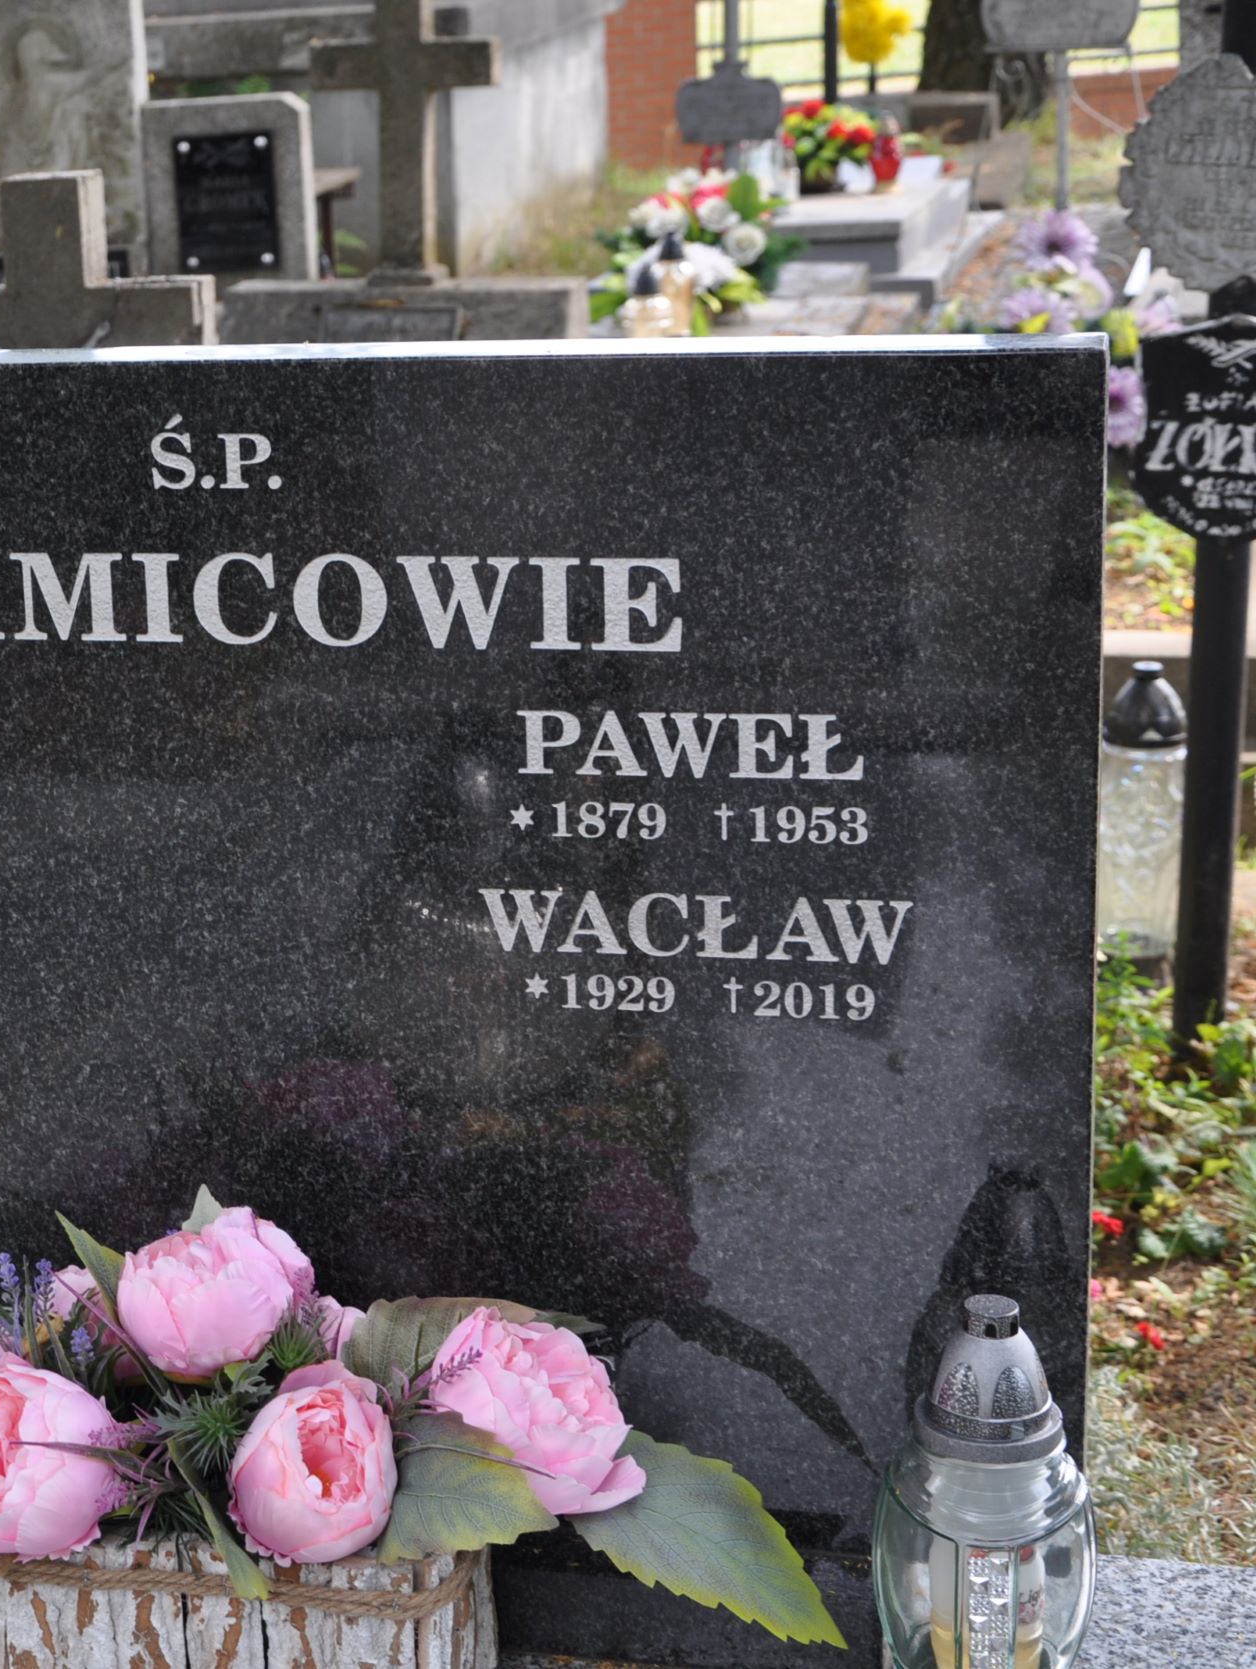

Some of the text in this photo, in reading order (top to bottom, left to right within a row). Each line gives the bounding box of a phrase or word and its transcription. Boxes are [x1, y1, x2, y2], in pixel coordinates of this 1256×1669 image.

[150, 413, 284, 491] Ś.P.
[516, 709, 865, 782] PAWEŁ
[477, 888, 914, 966] WACŁAW
